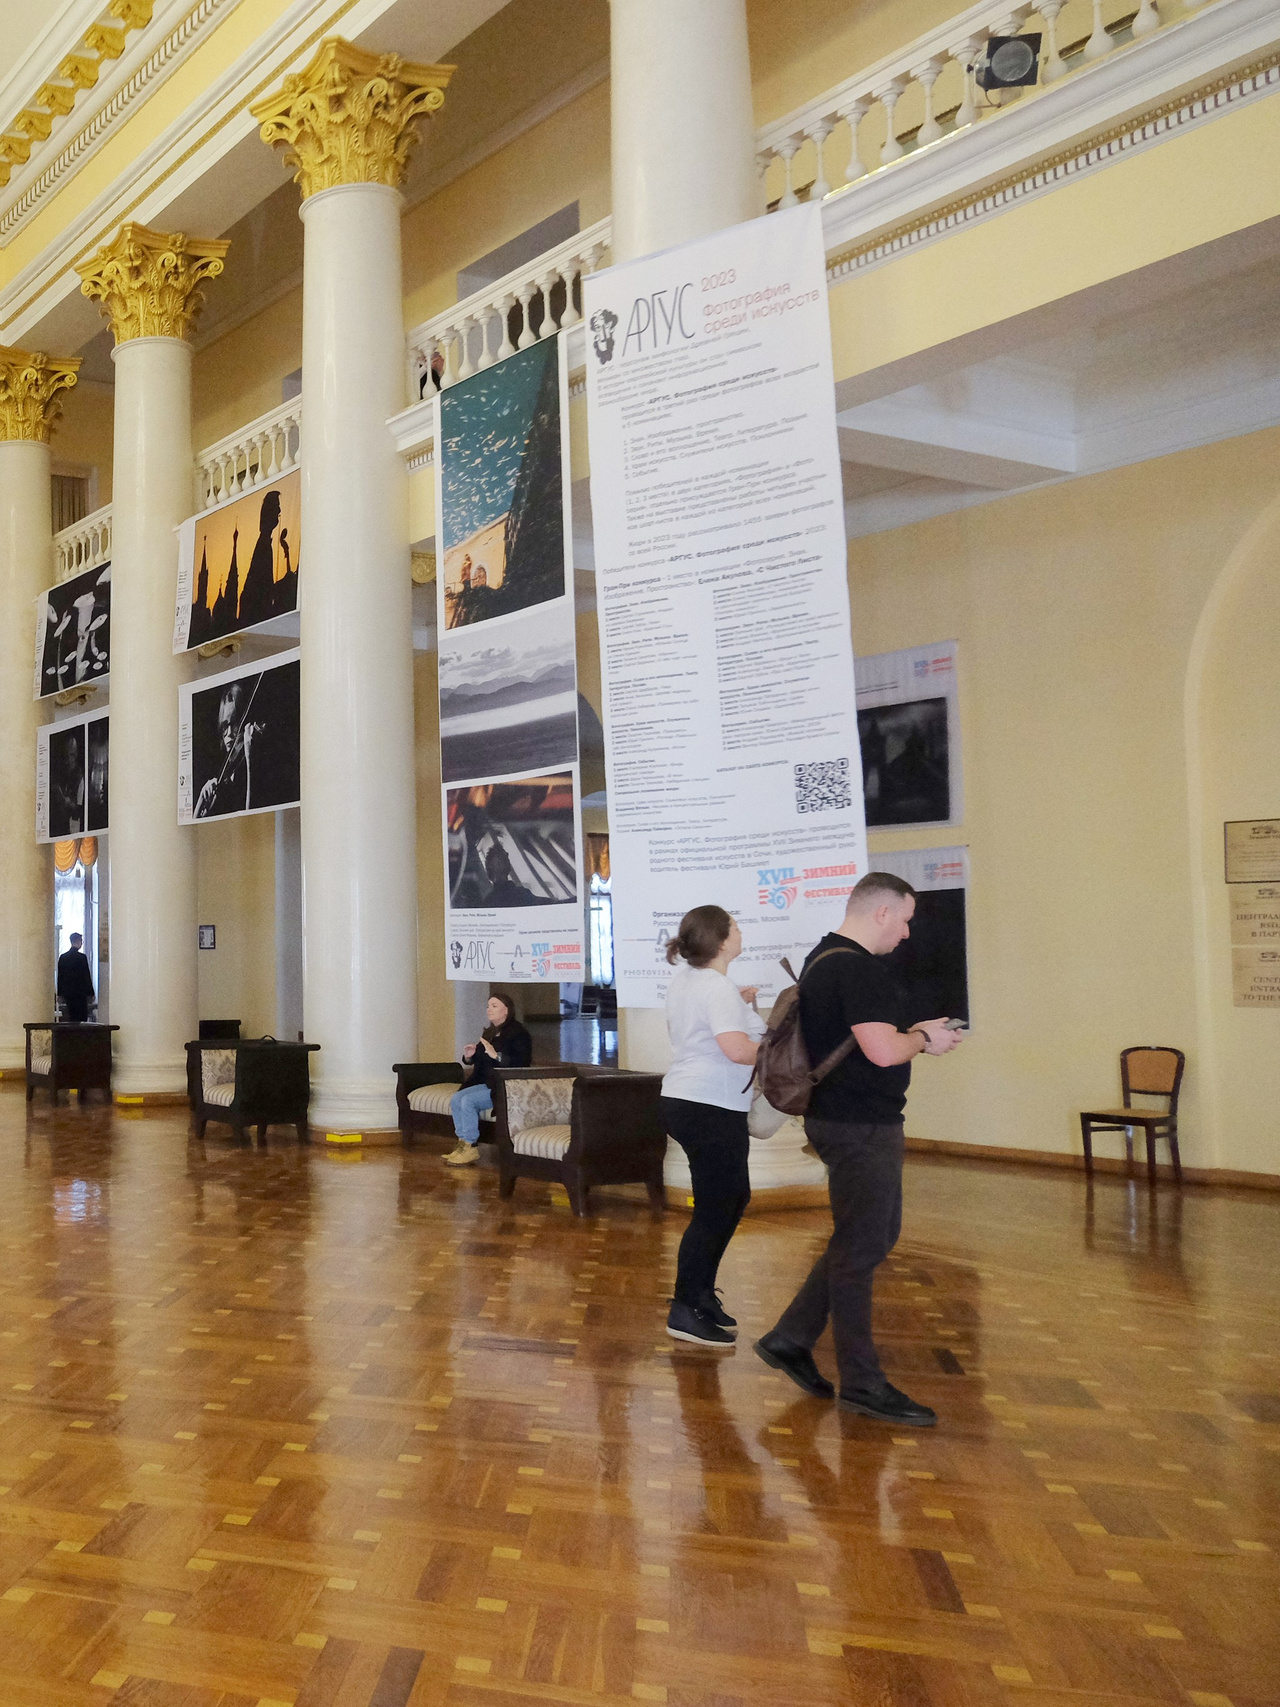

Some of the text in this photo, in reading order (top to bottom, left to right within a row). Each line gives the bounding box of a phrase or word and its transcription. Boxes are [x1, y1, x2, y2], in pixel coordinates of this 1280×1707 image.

[701, 269, 737, 293] 2023
[703, 282, 791, 318] Фотография
[704, 288, 819, 334] среди искусств
[622, 282, 696, 357] АРГУС
[802, 861, 856, 880] ЗИМНИЙ
